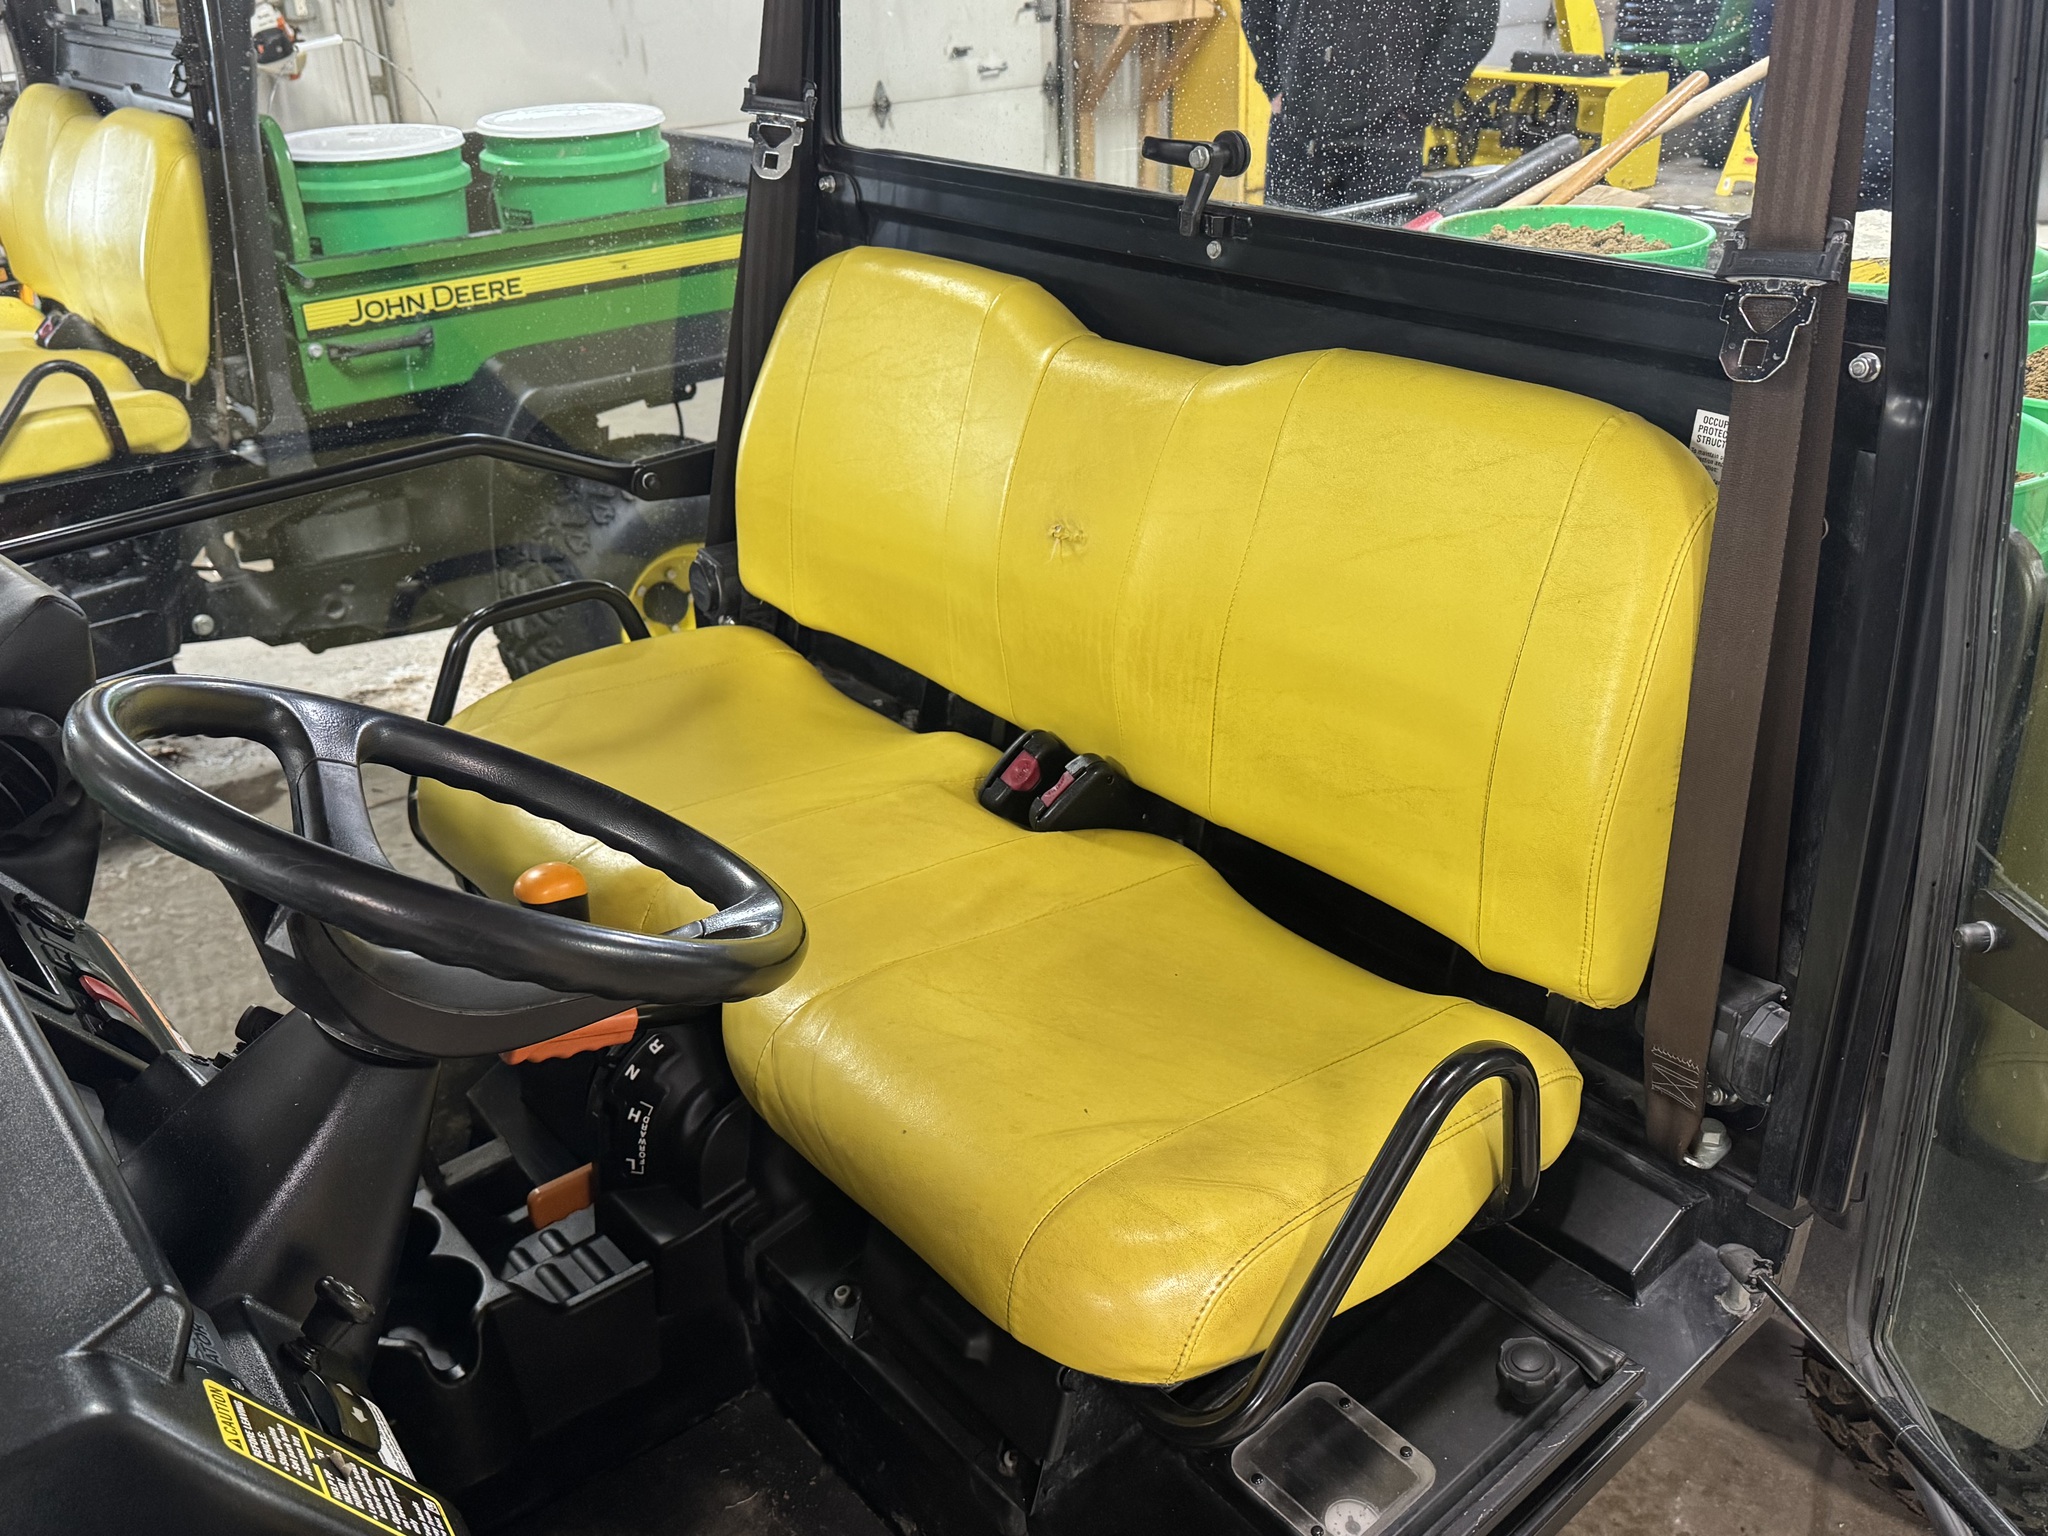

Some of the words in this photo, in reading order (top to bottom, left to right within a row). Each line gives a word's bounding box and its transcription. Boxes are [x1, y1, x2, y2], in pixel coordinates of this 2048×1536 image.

[349, 293, 425, 322] JOHN
[432, 277, 523, 308] DEERE
[649, 1039, 664, 1054] R
[625, 1064, 640, 1080] N
[627, 1107, 641, 1122] H
[638, 1115, 651, 1165] FORWARD
[625, 1158, 635, 1170] L
[210, 1386, 237, 1435] CAUTION
[234, 1400, 252, 1430] LEAVING
[268, 1426, 282, 1449] engine
[277, 1423, 289, 1442] brake
[291, 1435, 301, 1447] key
[245, 1429, 263, 1458] BEFORE
[281, 1440, 298, 1459] park
[278, 1450, 289, 1466] Stop
[287, 1456, 301, 1471] Set
[296, 1448, 313, 1476] Remove
[328, 1480, 342, 1500] HELP
[336, 1477, 354, 1504] INJURY
[364, 1497, 377, 1514] Lock
